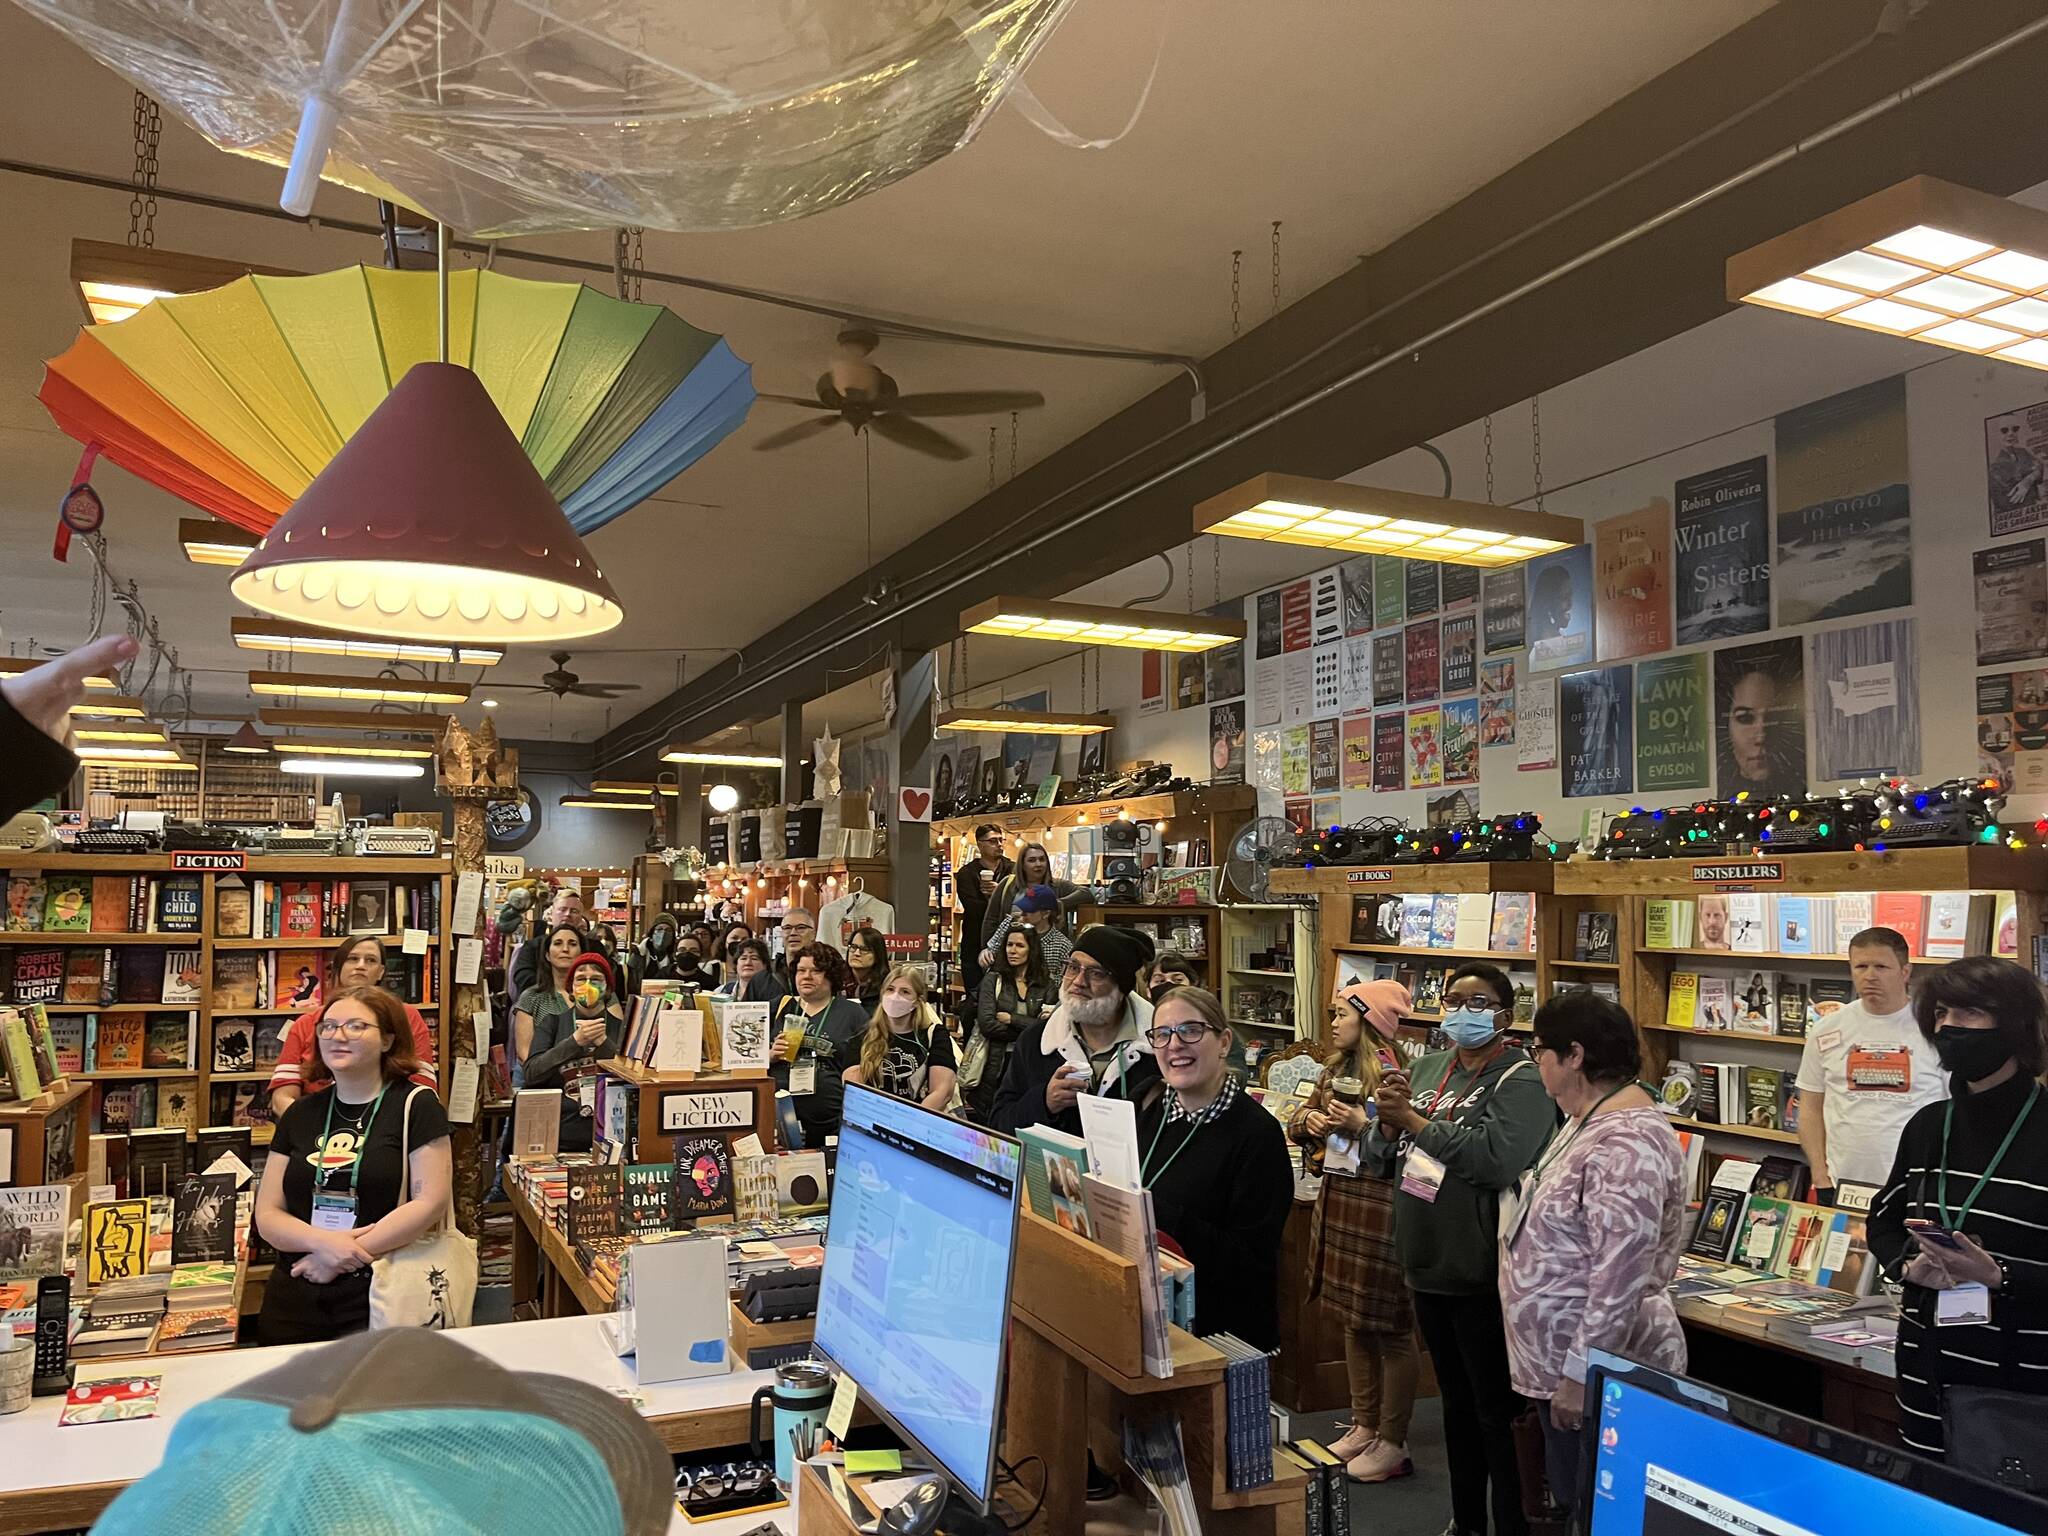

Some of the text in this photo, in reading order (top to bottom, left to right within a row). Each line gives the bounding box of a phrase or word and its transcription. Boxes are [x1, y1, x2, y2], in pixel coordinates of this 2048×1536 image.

[1681, 483, 1762, 513] Robin Oliveira
[1618, 527, 1646, 543] This
[1674, 521, 1749, 554] Winter
[1812, 519, 1873, 543] HILLS
[1694, 563, 1770, 593] Sisters
[1444, 619, 1473, 634] FLORIDA
[1487, 615, 1522, 634] RUIN
[1407, 648, 1438, 660] WINTERS
[1446, 655, 1472, 667] LAUREN
[1448, 667, 1470, 680] GROFF
[1640, 677, 1704, 703] LAWN
[1648, 705, 1693, 730] BOY
[1638, 740, 1705, 758] JONATHAN
[1376, 752, 1393, 763] CITY
[1570, 753, 1592, 766] PAT
[1574, 767, 1622, 782] BARKER
[1648, 762, 1696, 778] EVISON
[176, 855, 242, 868] FICTION
[1347, 871, 1390, 882] GIFT BOOKS
[1693, 865, 1778, 880] BESTSELLERS
[172, 891, 191, 902] LEE
[165, 902, 196, 913] CHILD
[17, 952, 63, 966] ROBERT
[17, 963, 62, 979] CRAIS
[1671, 977, 1694, 988] LEGO
[20, 985, 58, 999] LIGHT
[102, 1033, 141, 1046] PLACE
[689, 1096, 728, 1111] NEW
[1409, 1086, 1485, 1111] Black
[672, 1110, 741, 1126] FICTION
[718, 1151, 730, 1176] THIEF
[572, 1172, 617, 1183] WHEN WE
[629, 1170, 670, 1185] SMALL
[6, 1191, 60, 1205] WILD
[578, 1196, 612, 1207] SISTERS
[633, 1192, 667, 1207] GAME
[3, 1211, 59, 1225] WORLD
[575, 1213, 609, 1223] FATIMA
[641, 1218, 660, 1226] BLAIR
